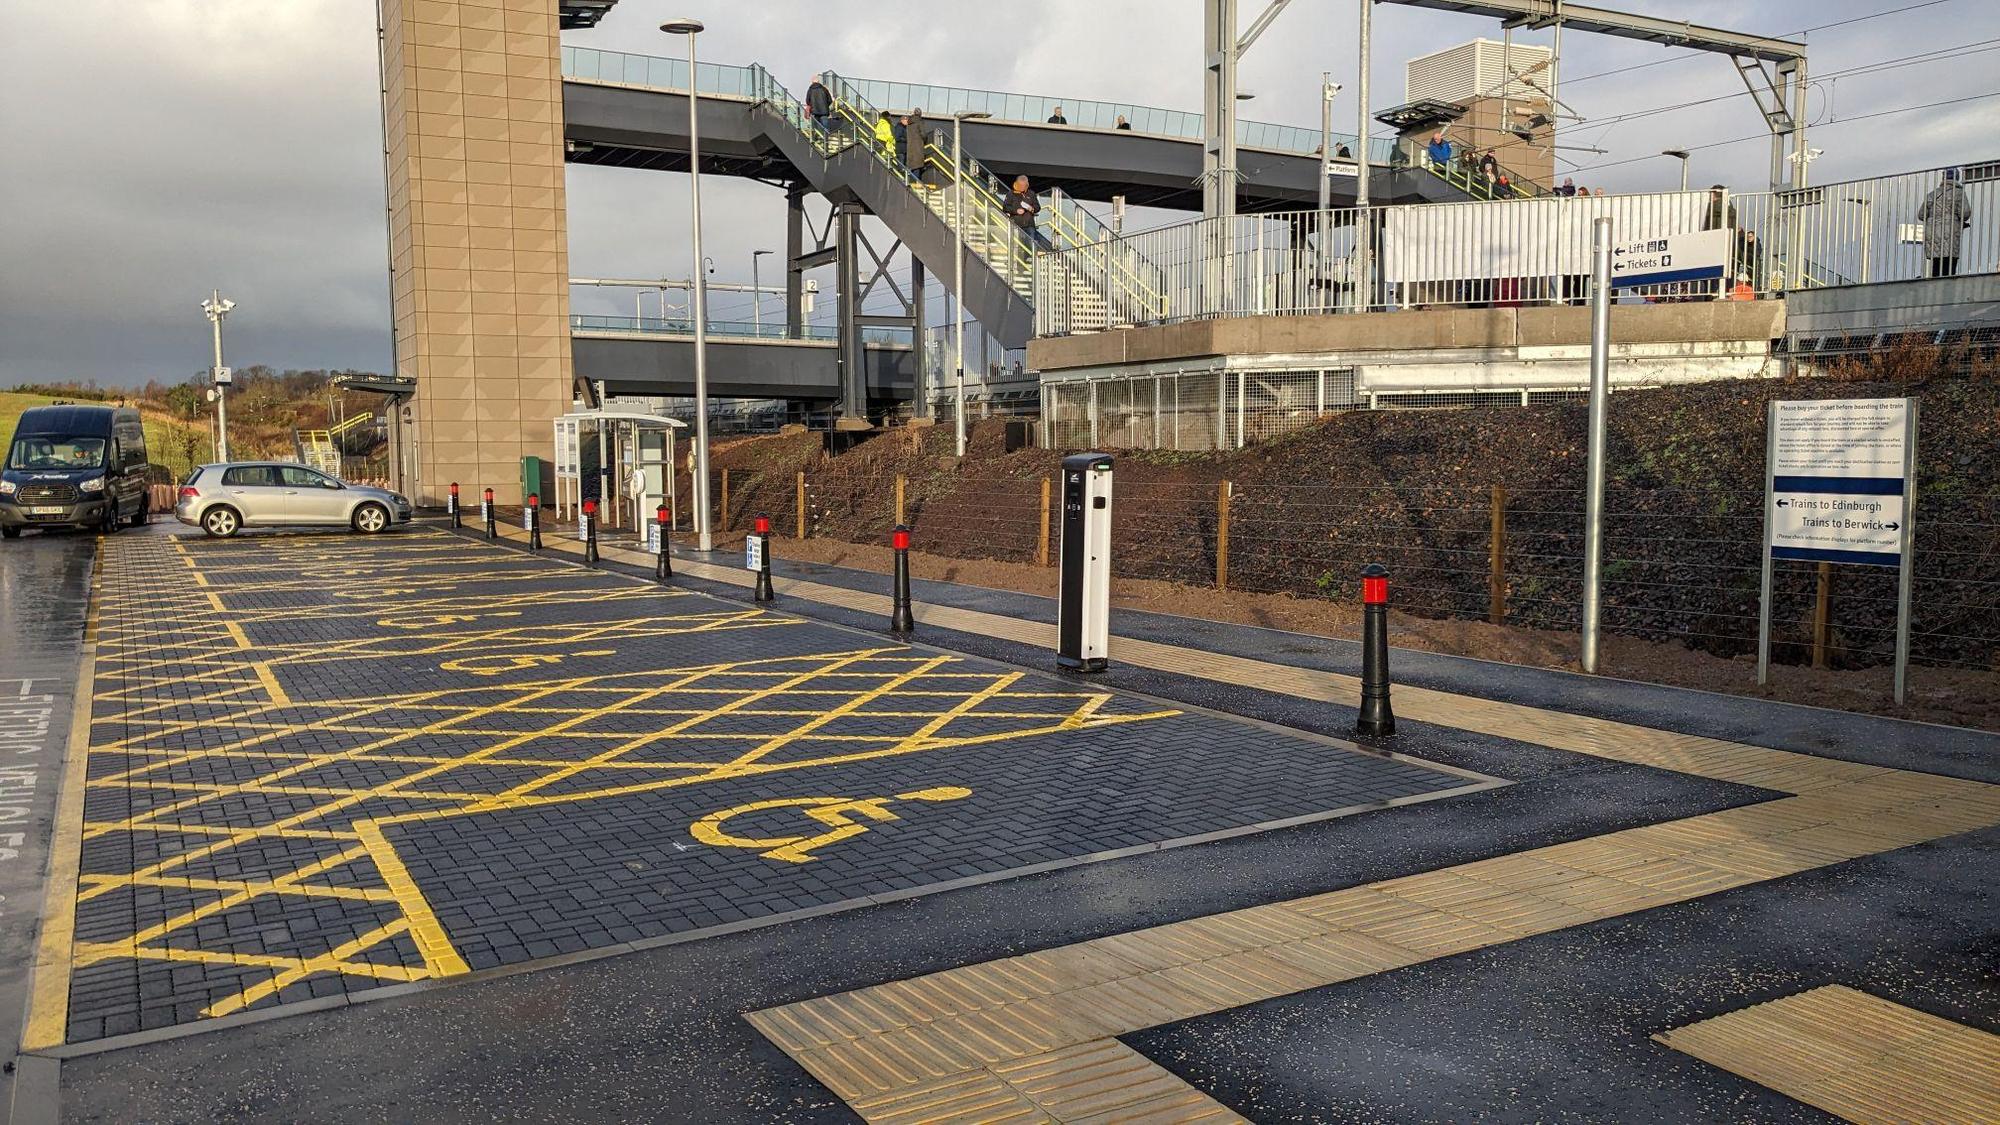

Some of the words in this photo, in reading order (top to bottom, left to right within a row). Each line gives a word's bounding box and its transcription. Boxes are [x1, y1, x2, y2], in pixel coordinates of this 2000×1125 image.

[1629, 244, 1644, 254] Lift
[1627, 259, 1657, 269] Tickets
[810, 281, 816, 290] 2
[1854, 403, 1878, 411] boarding
[1790, 498, 1817, 509] Trains
[1820, 500, 1830, 509] to
[1832, 500, 1882, 513] Edinburgh
[1802, 517, 1830, 528] Trains
[1832, 519, 1842, 529] to
[1844, 519, 1884, 531] Berwick
